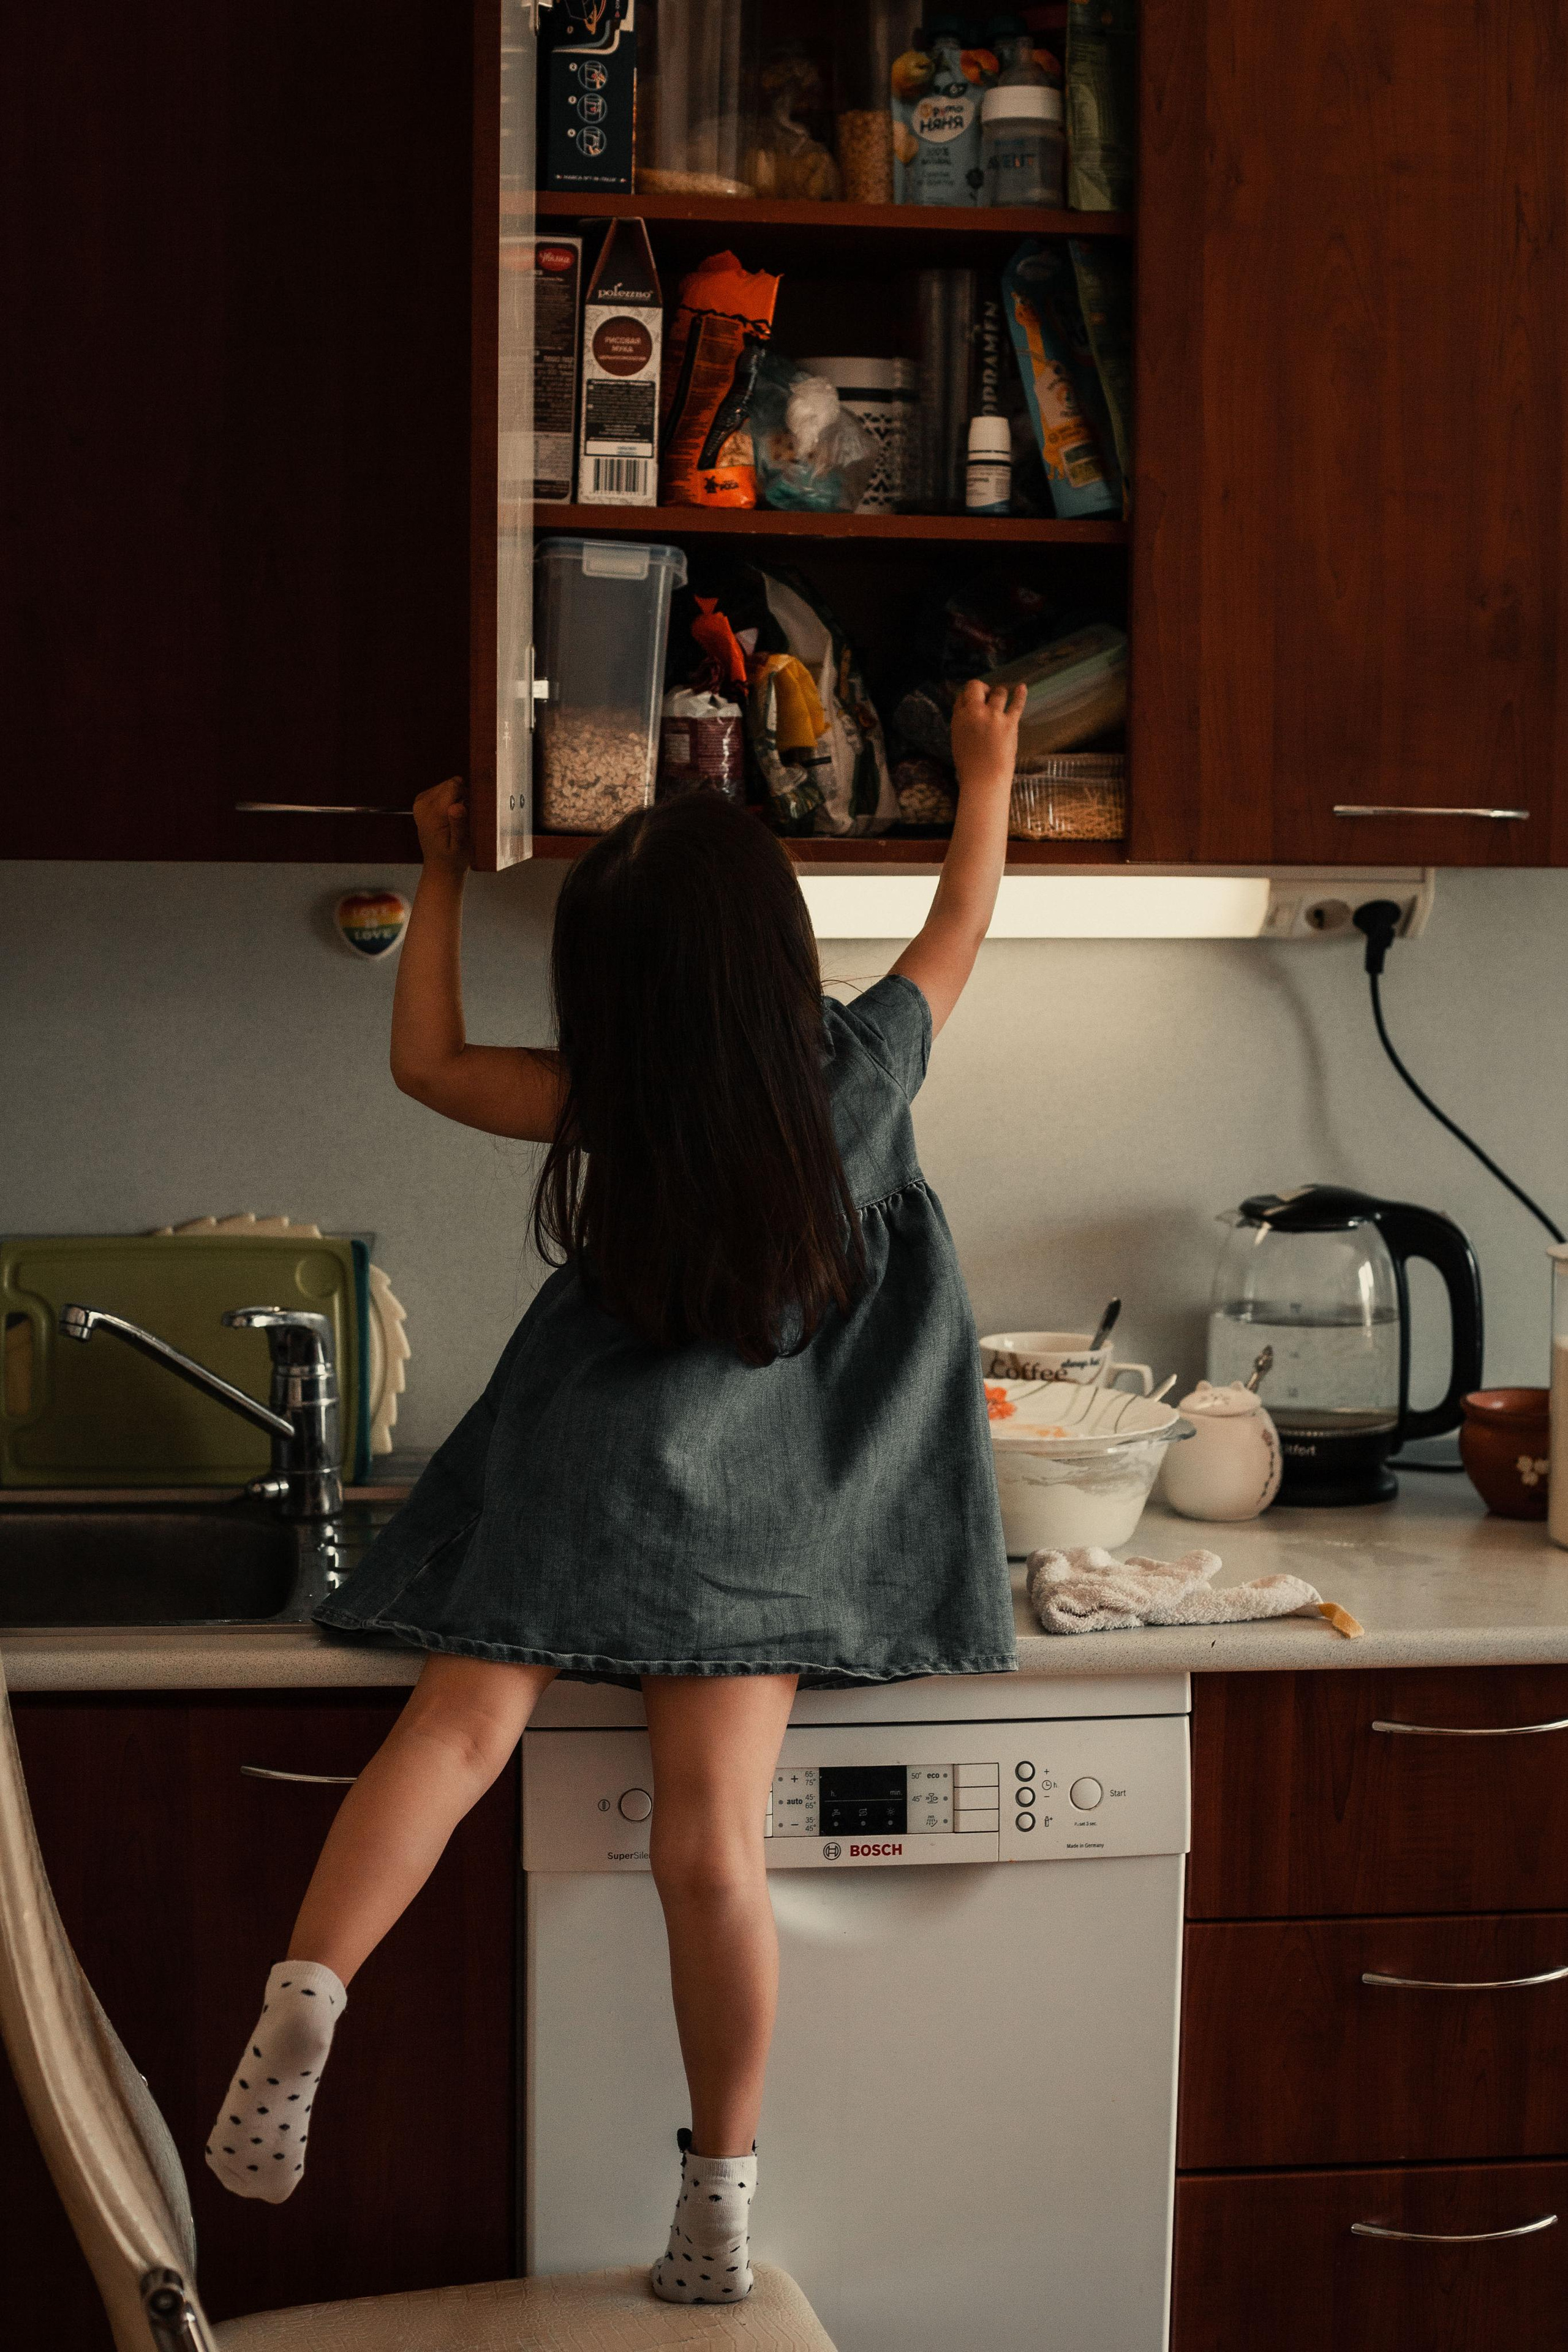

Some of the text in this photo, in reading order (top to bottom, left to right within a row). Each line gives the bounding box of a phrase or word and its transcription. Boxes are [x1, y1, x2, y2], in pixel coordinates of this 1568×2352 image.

[919, 116, 963, 134] НЯНЯ
[987, 1353, 1067, 1381] Coffee
[607, 1852, 650, 1861] SuperSile
[850, 1844, 903, 1857] BOSCH
